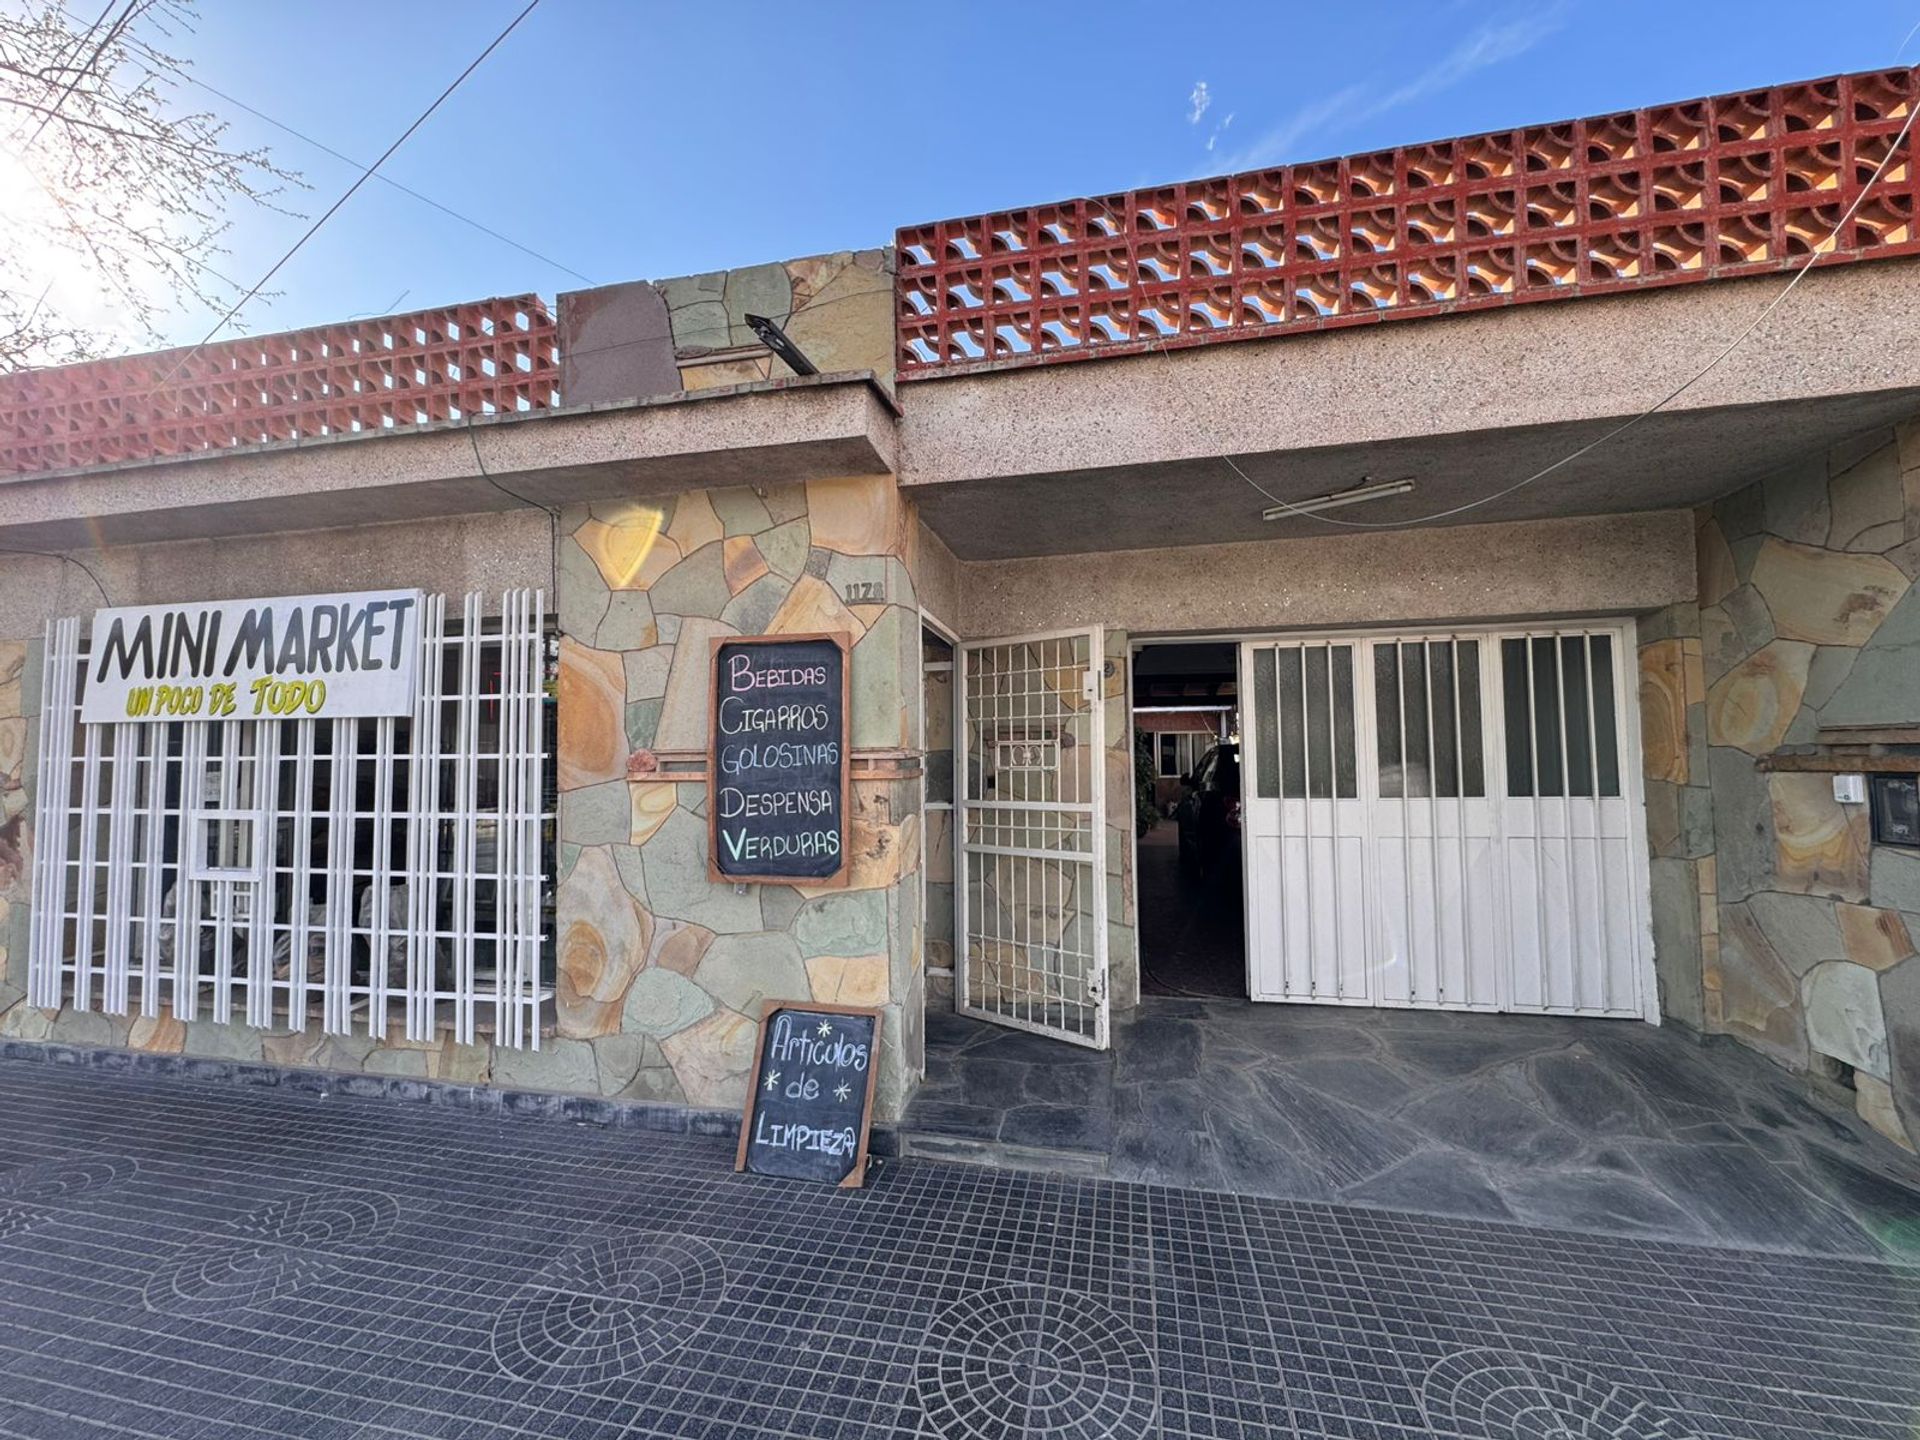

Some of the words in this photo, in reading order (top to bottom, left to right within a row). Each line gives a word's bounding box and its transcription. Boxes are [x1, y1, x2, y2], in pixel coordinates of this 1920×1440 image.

[96, 610, 222, 683] MINI
[223, 598, 415, 677] MARKET
[728, 654, 826, 692] BEBIDAS
[126, 686, 154, 717] UN
[153, 685, 204, 716] POCO
[208, 682, 237, 716] DE
[250, 675, 327, 715] TODO
[719, 696, 829, 734] CIGARROS
[721, 742, 839, 776] GOLOSINAS
[719, 787, 833, 818] DESPENSA
[722, 827, 840, 862] VERDURAS
[785, 1071, 820, 1100] de
[755, 1111, 856, 1158] LIMPIEZA
